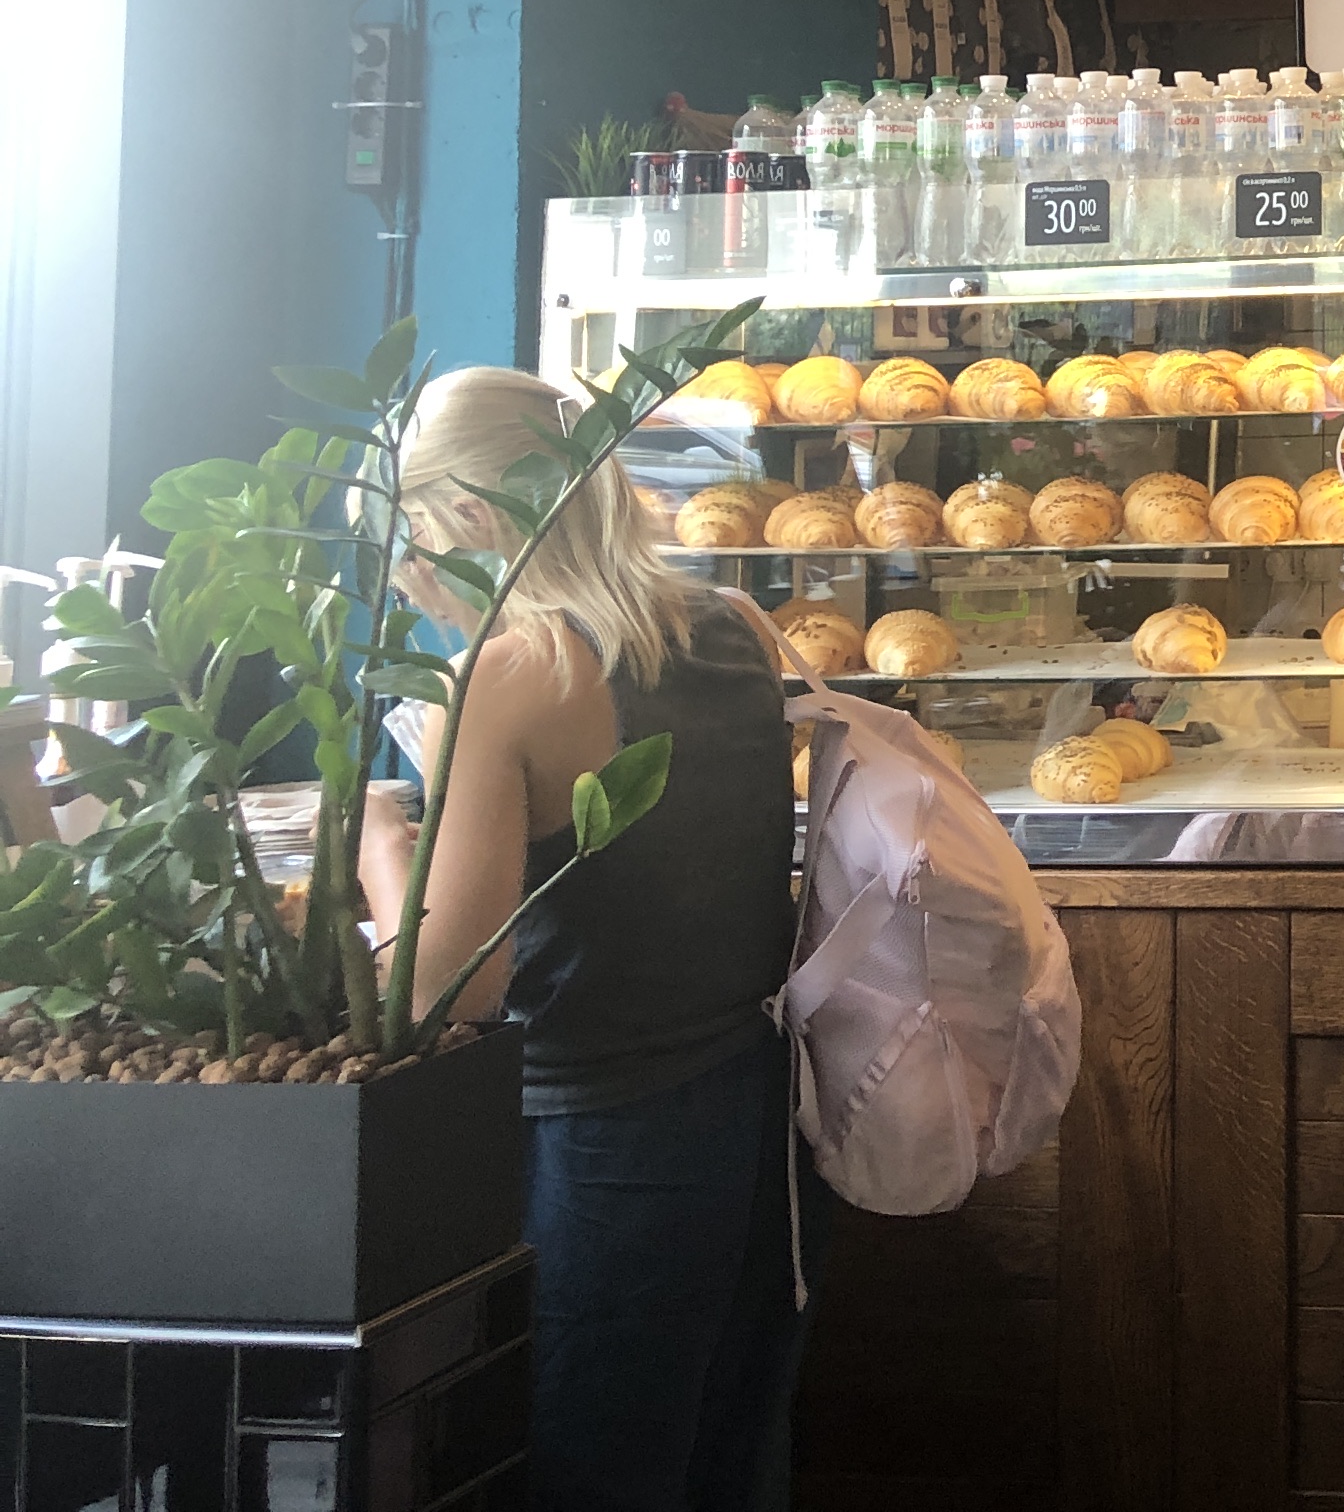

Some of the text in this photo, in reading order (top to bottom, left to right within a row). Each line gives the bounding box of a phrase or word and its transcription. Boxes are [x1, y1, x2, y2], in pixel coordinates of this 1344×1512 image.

[1043, 198, 1097, 234] 30 00
[1255, 190, 1309, 226] 25 00
